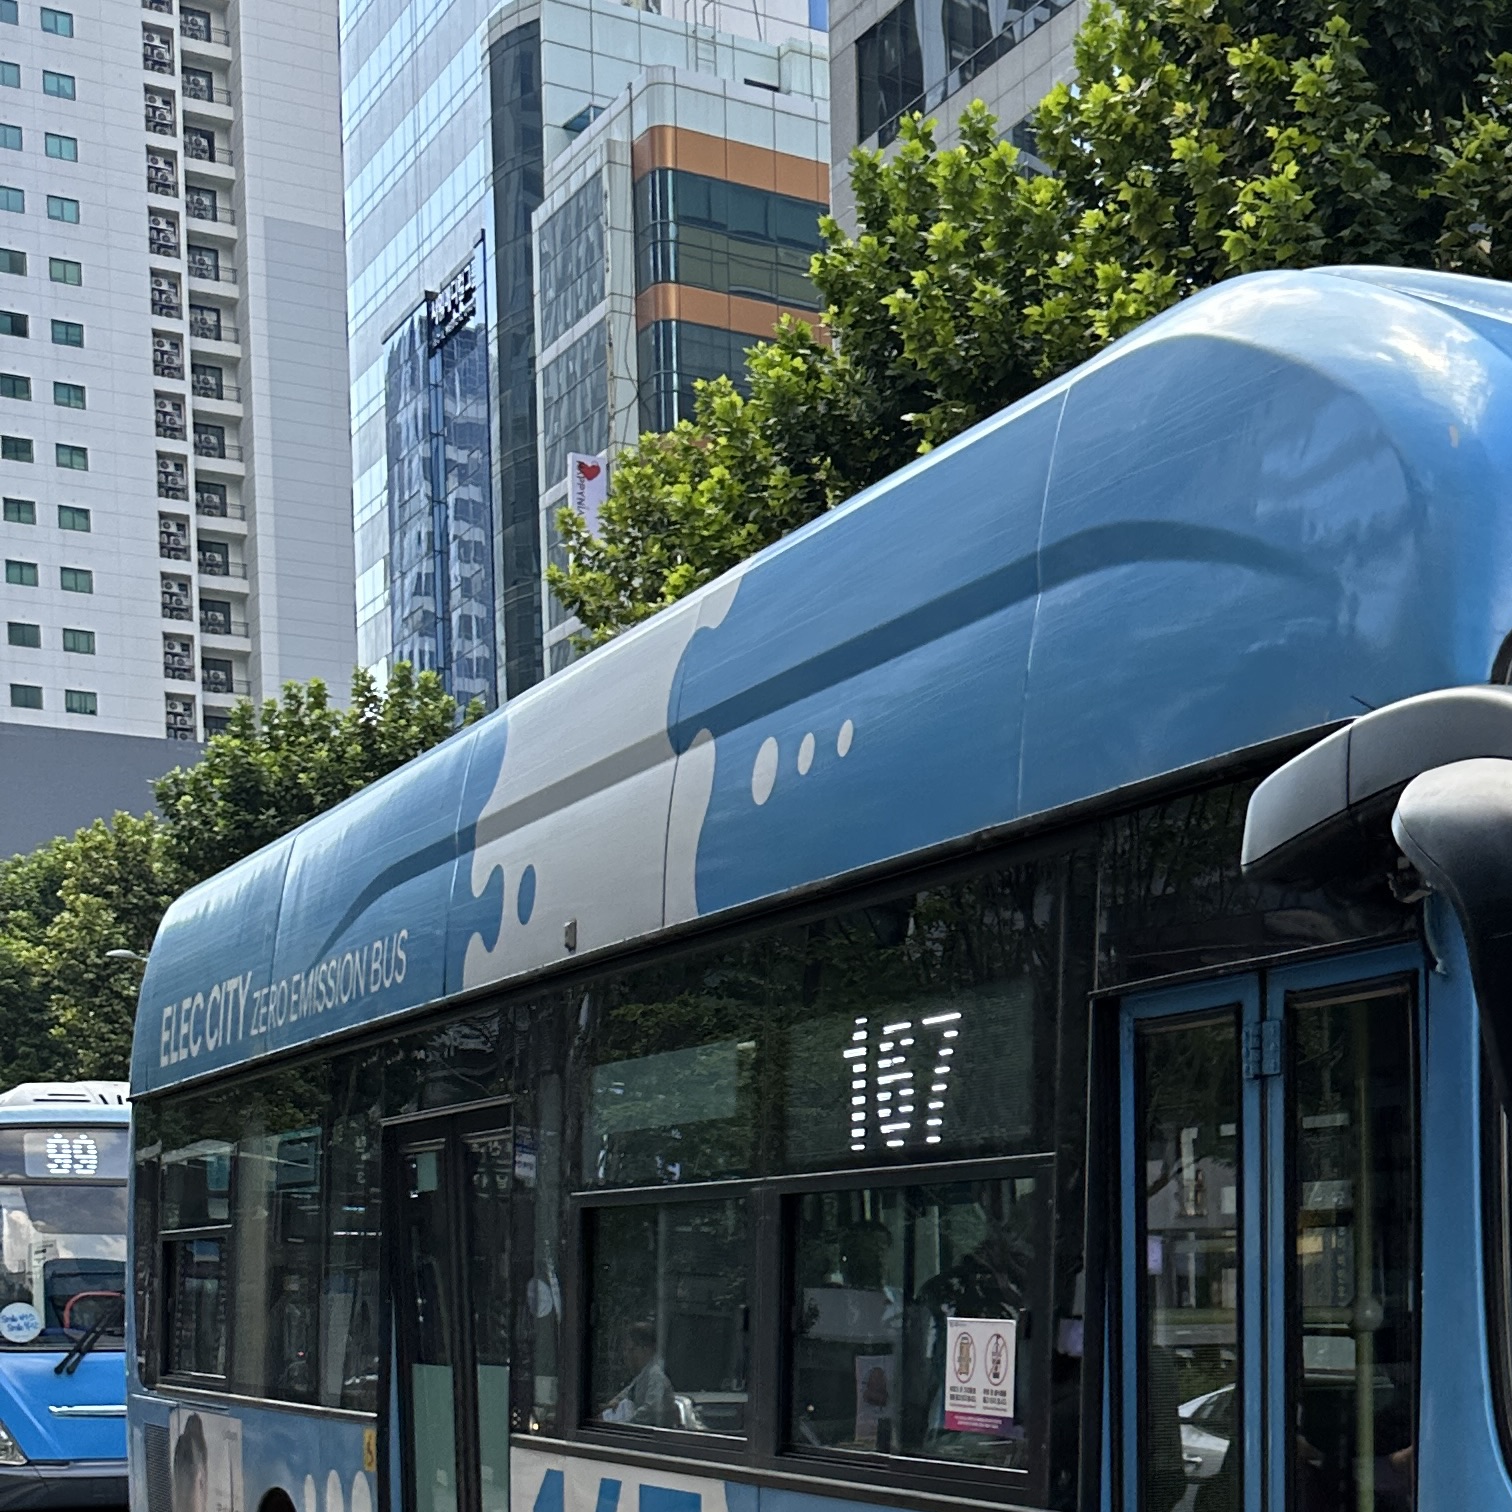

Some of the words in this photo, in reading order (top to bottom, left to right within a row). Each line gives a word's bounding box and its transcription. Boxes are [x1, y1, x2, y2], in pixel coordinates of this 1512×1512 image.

[160, 992, 205, 1068] ELEC
[205, 971, 252, 1052] CITY
[250, 980, 288, 1036] ZERO
[289, 945, 369, 1022] EMISSION
[370, 929, 409, 993] BUS
[843, 1012, 962, 1151] 167
